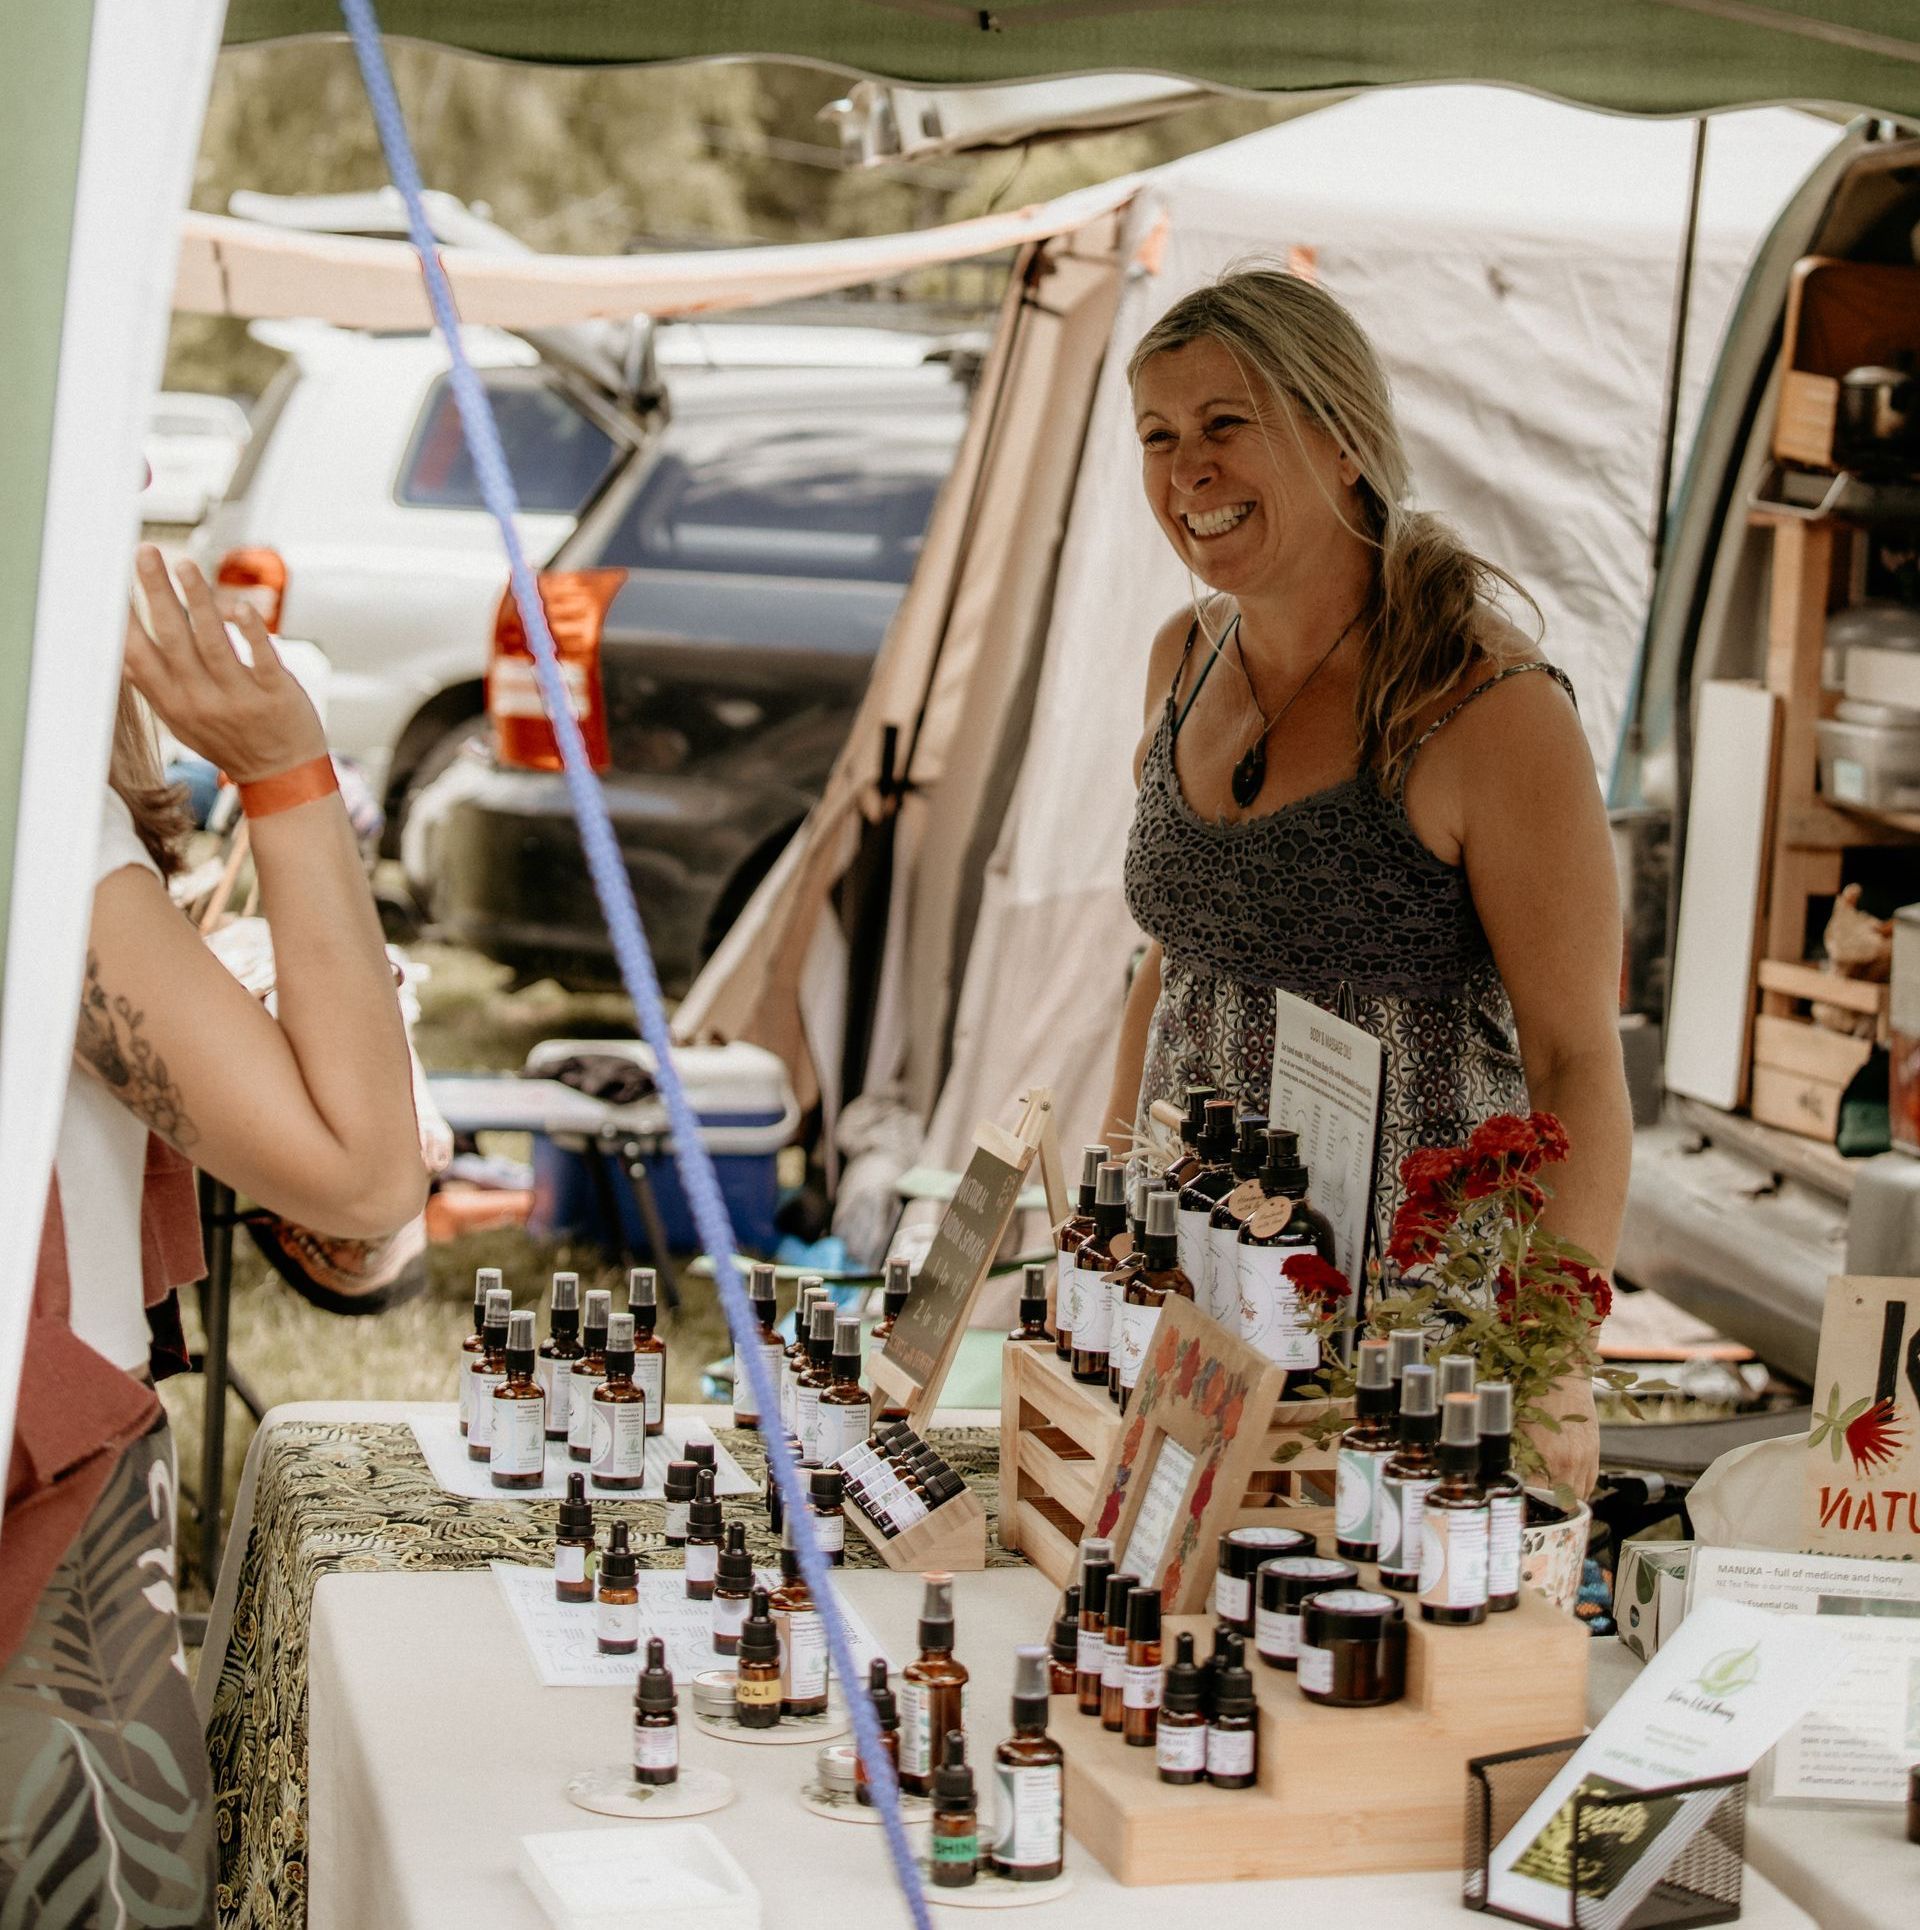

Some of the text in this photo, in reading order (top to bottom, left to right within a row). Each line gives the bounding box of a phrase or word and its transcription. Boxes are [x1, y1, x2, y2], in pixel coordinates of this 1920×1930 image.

[1718, 1565, 1763, 1576] MANUKA
[1774, 1567, 1790, 1577] full
[1792, 1569, 1803, 1578] of
[1805, 1571, 1849, 1581] medicine
[1852, 1573, 1870, 1583] and
[1872, 1574, 1904, 1586] honey
